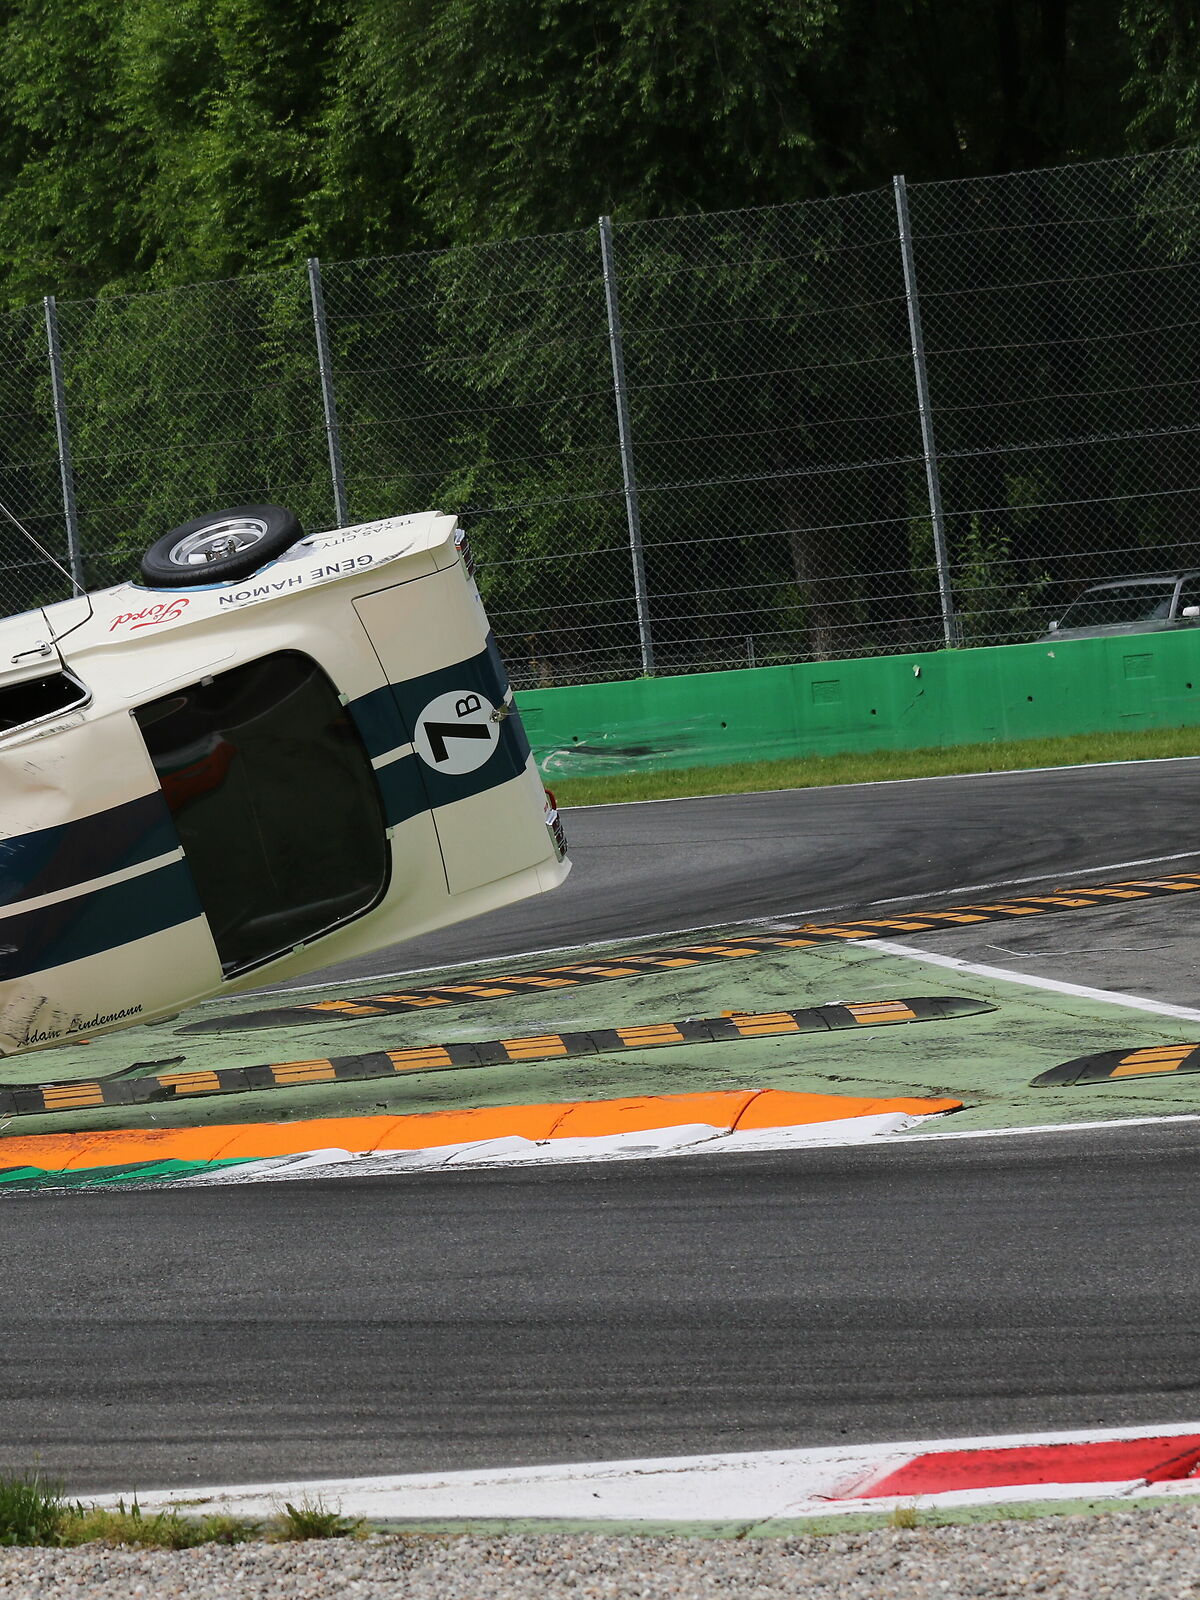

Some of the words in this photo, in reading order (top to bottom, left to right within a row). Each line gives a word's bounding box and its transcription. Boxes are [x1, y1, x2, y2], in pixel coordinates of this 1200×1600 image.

[342, 521, 392, 536] TEXAS
[362, 519, 414, 537] TEXAS
[322, 534, 357, 549] CITY
[310, 554, 373, 579] GENE
[219, 575, 302, 605] HAMON
[109, 598, 190, 632] Ford
[17, 1029, 60, 1047] Adam
[66, 1004, 143, 1034] Lindemann
